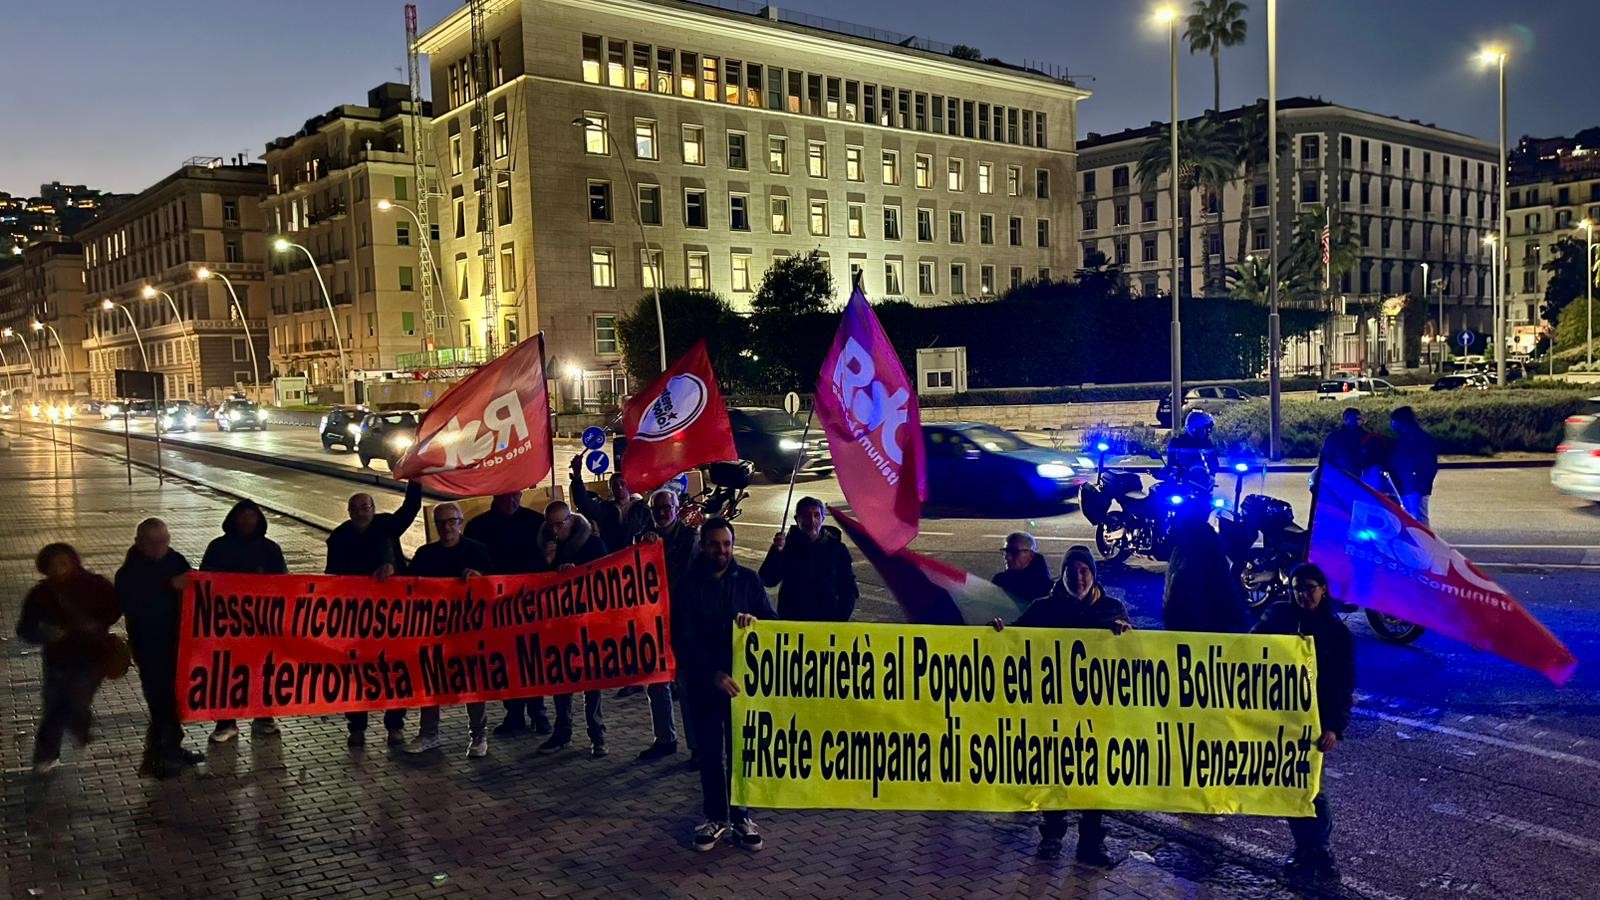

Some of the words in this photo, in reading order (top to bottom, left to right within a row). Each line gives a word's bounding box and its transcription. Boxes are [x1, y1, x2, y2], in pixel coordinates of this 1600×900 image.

[192, 580, 286, 638] Nessun
[292, 583, 486, 639] riconoscimento
[493, 550, 659, 627] internazionale
[188, 651, 250, 711] alla
[262, 650, 413, 707] terrorista
[418, 640, 510, 696] Maria
[516, 616, 667, 688] Machado!
[744, 632, 875, 700] Solidarietà
[883, 636, 905, 700] al
[914, 637, 995, 718] Popolo
[1003, 640, 1033, 704] ed
[1041, 640, 1063, 704] al
[1070, 640, 1170, 708] Governo
[1177, 644, 1312, 712] Bolivariano
[742, 710, 813, 779] #Rete
[820, 729, 931, 798] campana
[940, 717, 961, 783] di
[969, 718, 1099, 786] solidarietà
[1107, 737, 1149, 786] con
[1157, 722, 1171, 787] il
[1177, 722, 1312, 789] Venezuela#
